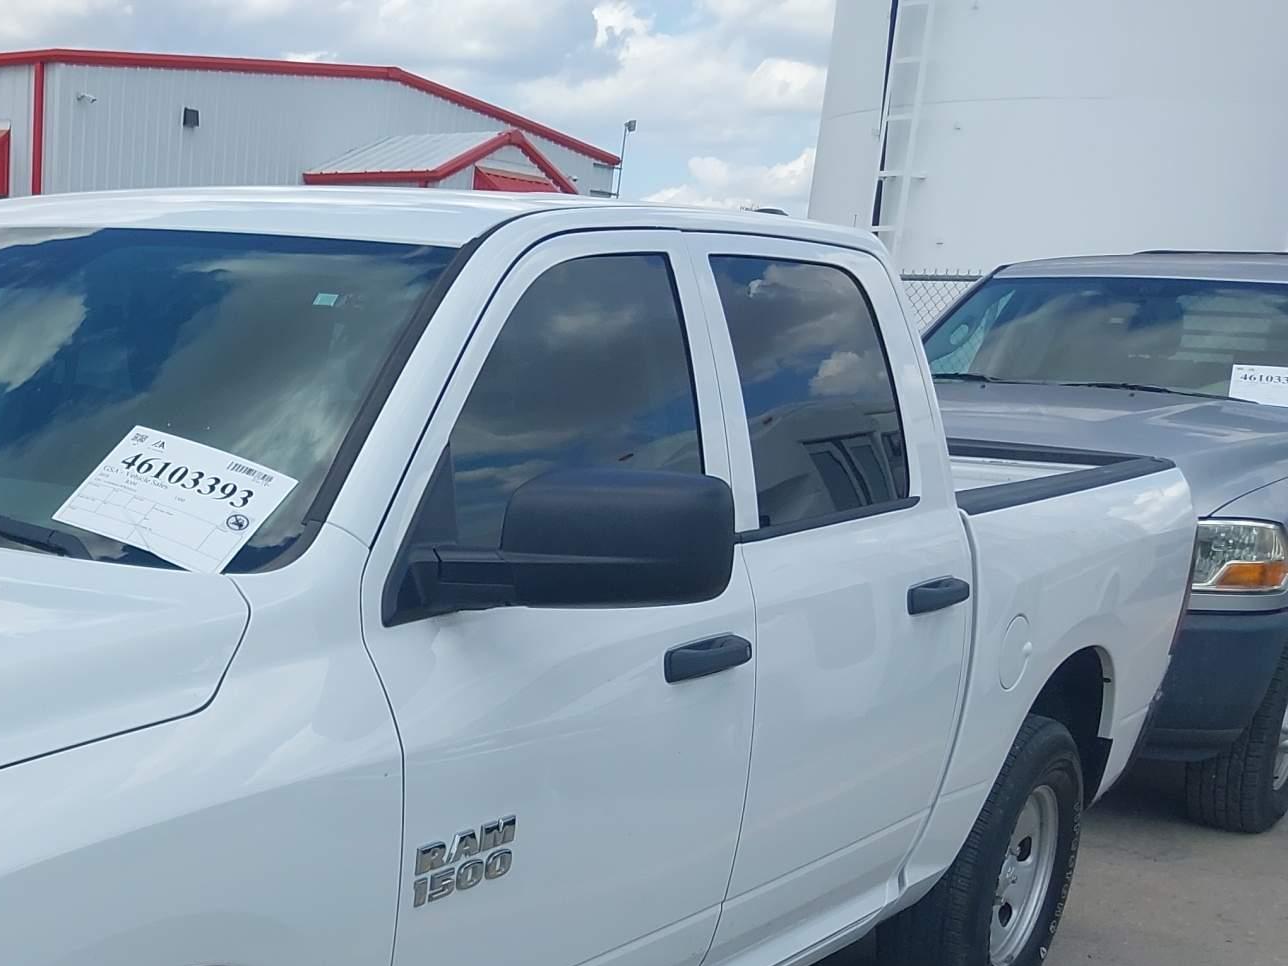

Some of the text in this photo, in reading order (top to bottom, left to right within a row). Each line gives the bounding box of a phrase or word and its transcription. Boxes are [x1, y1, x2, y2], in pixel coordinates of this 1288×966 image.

[120, 453, 254, 508] 46103393
[415, 814, 516, 877] RAM
[413, 848, 513, 908] 1500
